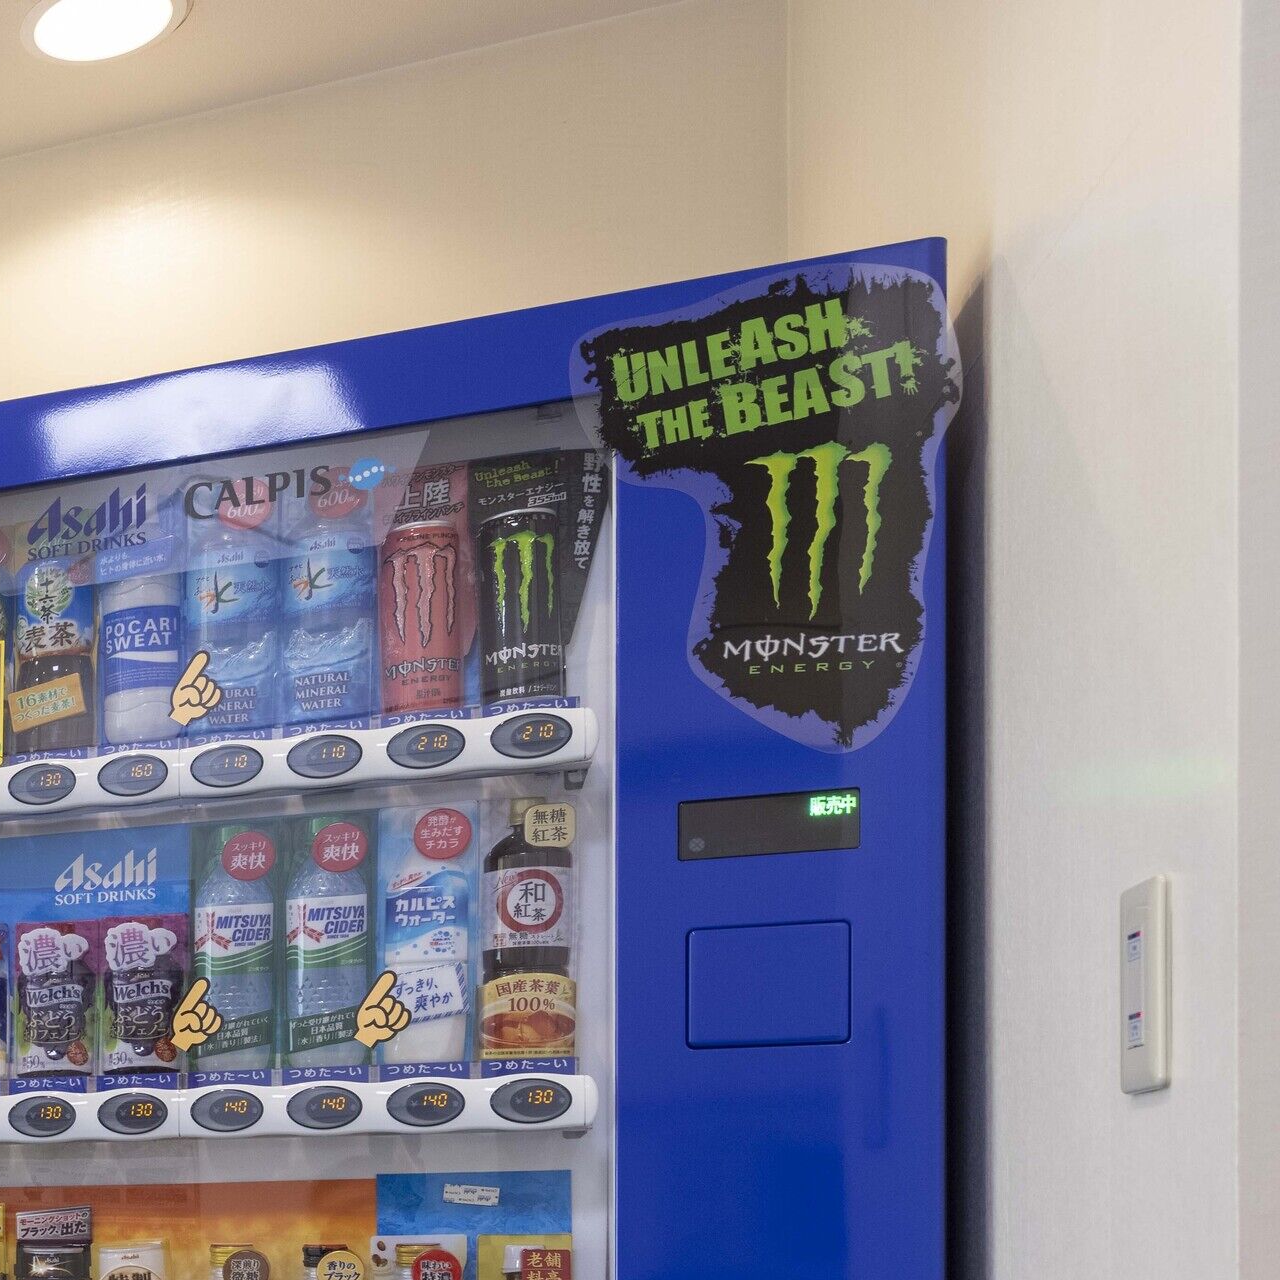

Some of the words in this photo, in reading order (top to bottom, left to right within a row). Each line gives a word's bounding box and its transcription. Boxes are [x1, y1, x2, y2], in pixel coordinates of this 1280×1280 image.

[611, 297, 846, 402] UNLEASH
[635, 398, 714, 449] THE
[716, 341, 921, 439] BEAST!
[474, 461, 530, 481] Unleash
[184, 465, 332, 520] CALPIS
[478, 483, 564, 506] モンスターエナジー
[25, 482, 147, 543] Asahi
[28, 542, 72, 561] SOFT
[77, 531, 147, 555] DRINKS
[106, 633, 172, 654] SWEAT
[722, 631, 905, 662] MONSTER
[750, 660, 876, 675] ENERGY
[295, 672, 350, 688] NATURAL
[295, 685, 349, 699] MINERAL
[300, 696, 344, 711] WATER
[208, 713, 249, 725] WATER
[532, 808, 567, 825] 無糖
[531, 826, 569, 843] 紅茶
[424, 839, 459, 850] チカラ
[230, 852, 266, 871] 爽快
[322, 845, 360, 863] 爽快
[54, 848, 158, 892] Asahi
[55, 891, 92, 905] SOFT
[96, 888, 157, 903] DRINKS
[395, 896, 456, 912] カルピス
[216, 913, 271, 930] MITSUYA
[308, 906, 365, 921] MITSUYA
[394, 912, 455, 927] ウォーター
[232, 927, 270, 942] CIDER
[324, 919, 365, 934] CIDER
[496, 979, 561, 997] 国産茶葉
[507, 997, 555, 1012] 100%
[223, 1100, 247, 1113] 140
[321, 1097, 346, 1110] 140
[422, 1093, 447, 1108] 140
[40, 1106, 62, 1119] 130
[129, 1103, 153, 1117] 130
